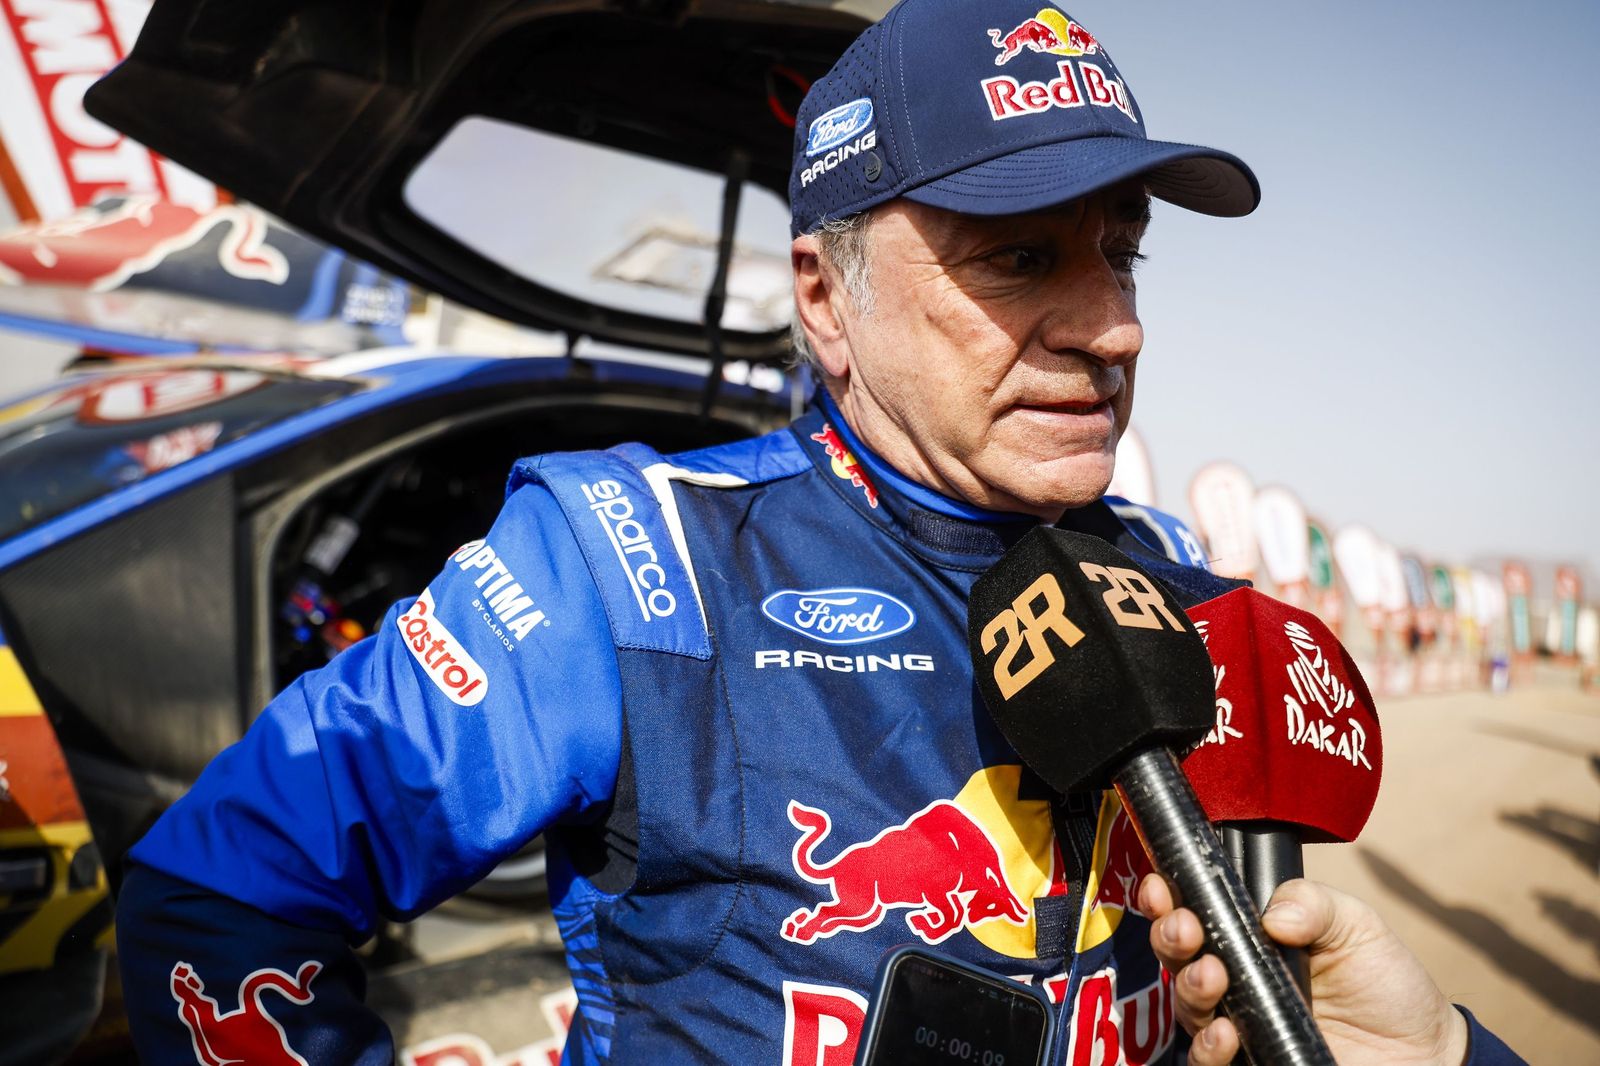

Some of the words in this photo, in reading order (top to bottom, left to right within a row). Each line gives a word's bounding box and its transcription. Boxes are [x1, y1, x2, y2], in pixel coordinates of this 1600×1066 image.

[983, 61, 1083, 119] Red
[811, 108, 861, 149] Ford
[800, 130, 875, 187] RACING
[588, 479, 677, 619] sparco
[471, 599, 485, 612] BY
[483, 612, 515, 652] CLARIOS
[794, 597, 884, 634] Ford
[1078, 561, 1187, 633] 2R
[755, 649, 935, 673] RACING
[980, 573, 1085, 701] 2R
[1283, 694, 1373, 771] DAKAR
[1071, 967, 1176, 1066] Bul
[914, 1026, 1005, 1066] 00:00:09
